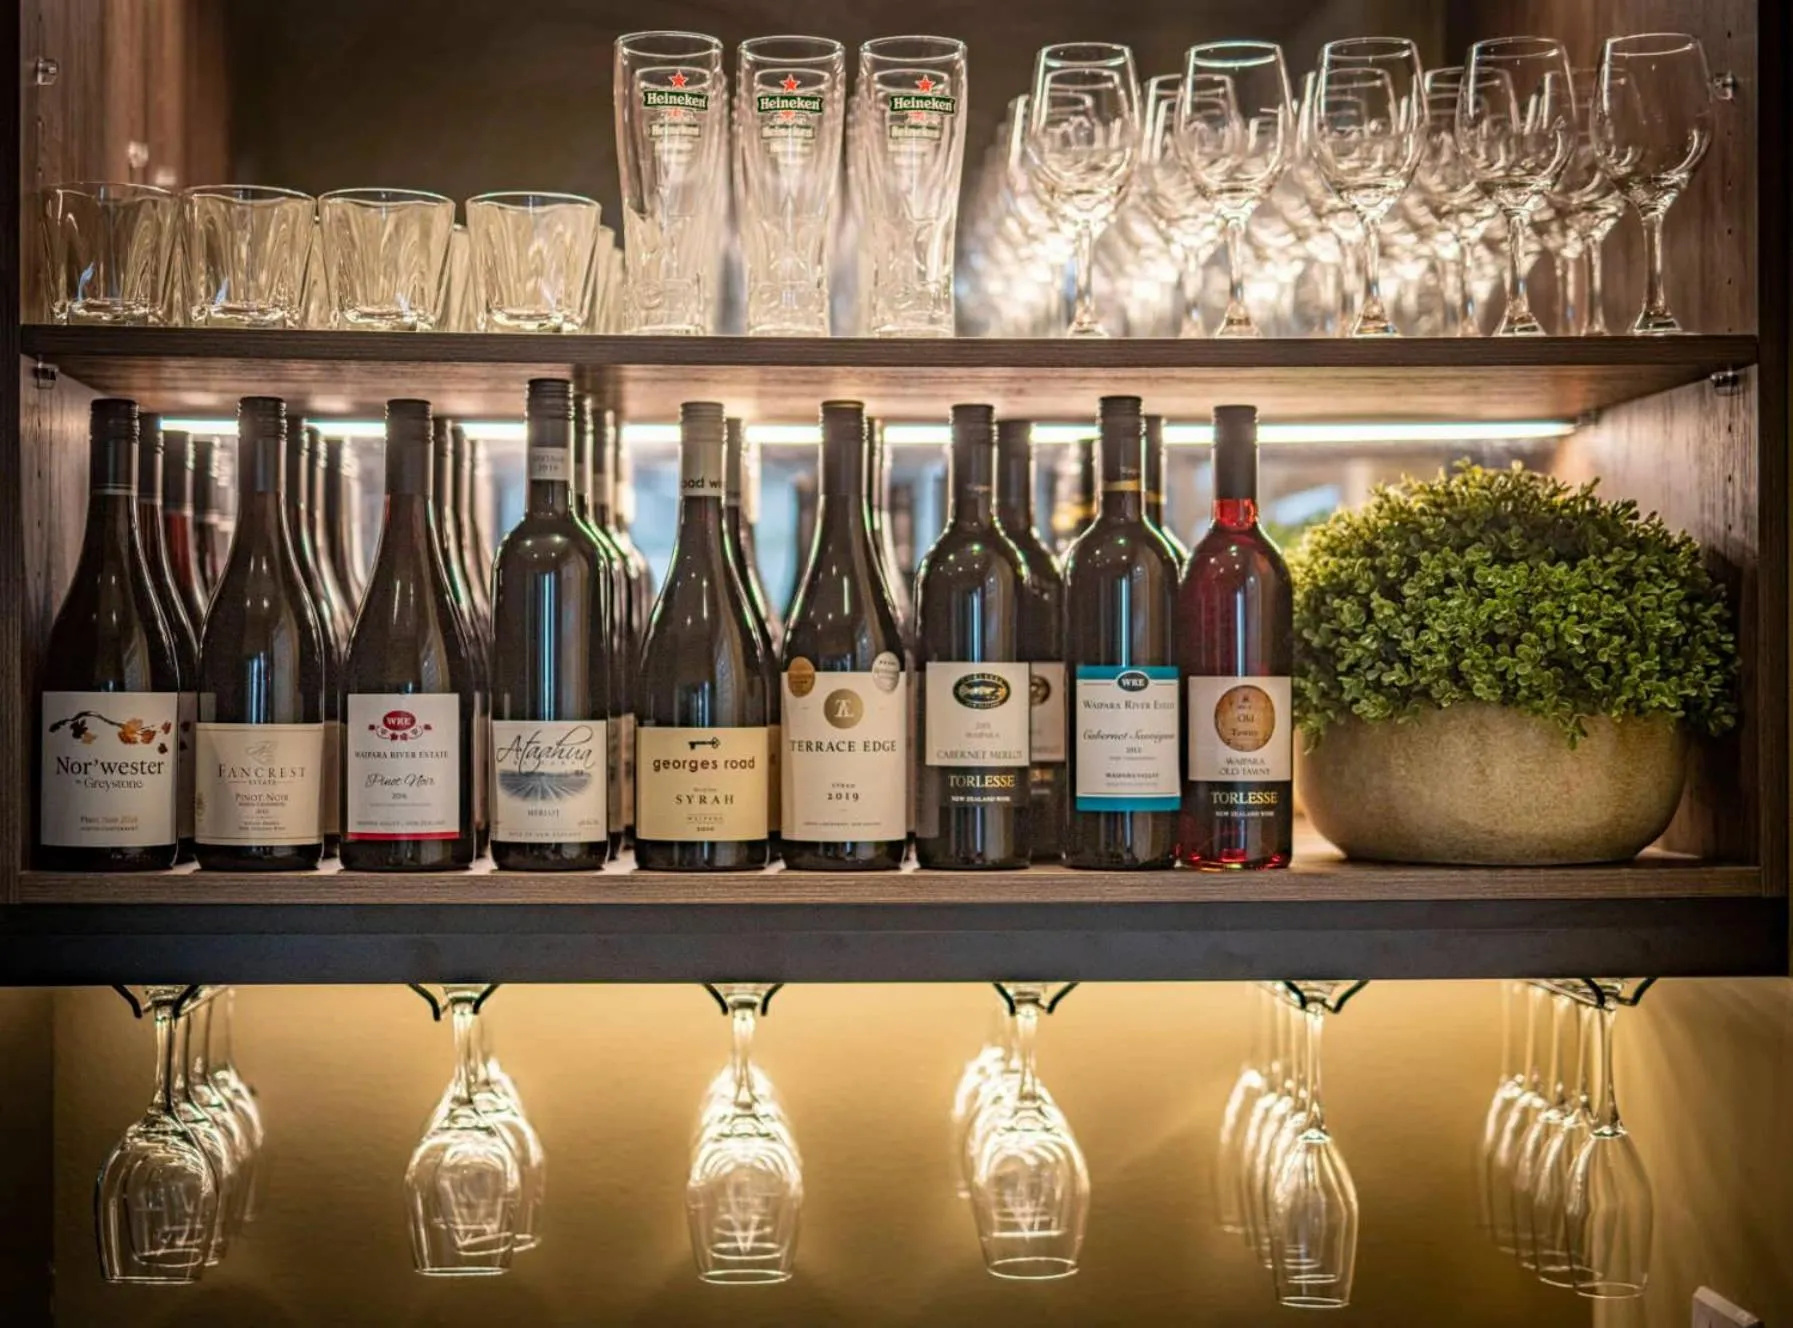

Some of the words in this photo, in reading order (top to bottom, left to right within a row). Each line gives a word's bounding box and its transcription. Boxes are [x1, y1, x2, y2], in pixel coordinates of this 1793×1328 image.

[647, 92, 706, 107] Heineken
[760, 97, 821, 111] Heineken
[893, 97, 953, 112] Heineken
[1121, 678, 1145, 687] WRE
[1083, 699, 1122, 709] WAIPARA
[1125, 700, 1151, 709] RIVER
[386, 716, 412, 726] WRE
[789, 740, 856, 753] TERRACE
[863, 740, 897, 753] EDGE
[354, 751, 387, 759] WAIPARA
[390, 751, 416, 759] RIVER
[936, 750, 986, 759] CABERNET
[56, 756, 165, 776] Nor'wester
[652, 758, 718, 773] georges
[724, 756, 756, 769] road
[1226, 757, 1266, 766] WAIPARA
[217, 763, 306, 778] FANCREST
[84, 777, 143, 792] Greystone
[948, 775, 1016, 788] TORLESSE
[235, 793, 262, 802] PINOT
[265, 792, 289, 801] NOIR
[675, 794, 734, 805] SYRAH
[827, 791, 860, 803] 2019
[1211, 791, 1279, 804] TORLESSE
